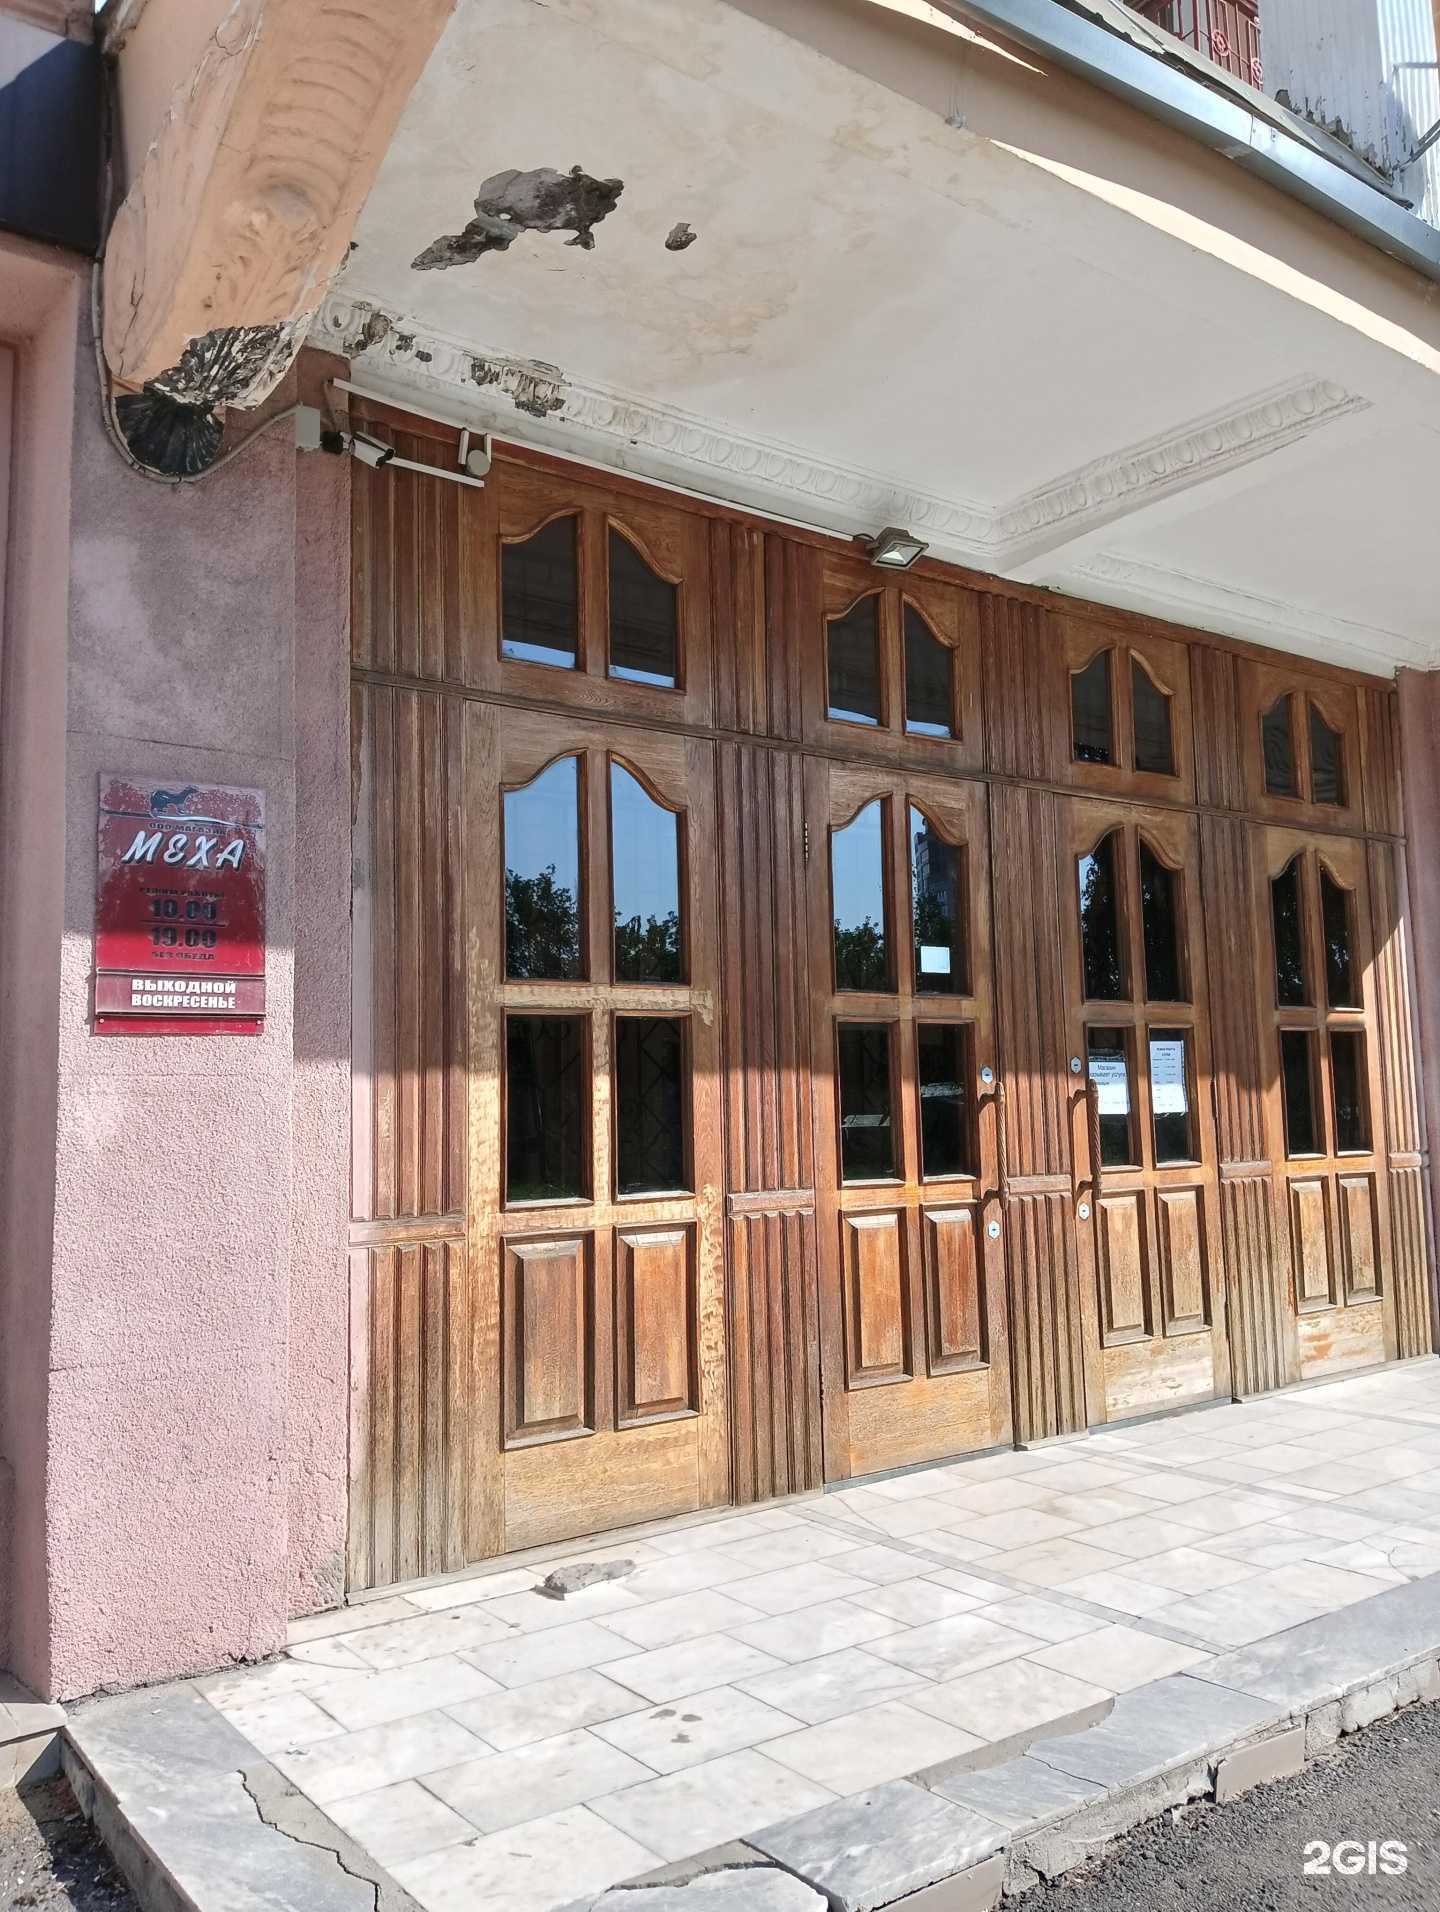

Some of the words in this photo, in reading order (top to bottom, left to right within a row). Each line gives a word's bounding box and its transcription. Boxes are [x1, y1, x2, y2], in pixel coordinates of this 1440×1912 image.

[122, 831, 248, 871] МЕХА
[152, 899, 217, 921] 10.00
[152, 926, 217, 948] 19.00
[132, 978, 236, 995] ВЫХОДНОЙ
[132, 995, 236, 1010] ВОСКРЕСЕНЬЕ
